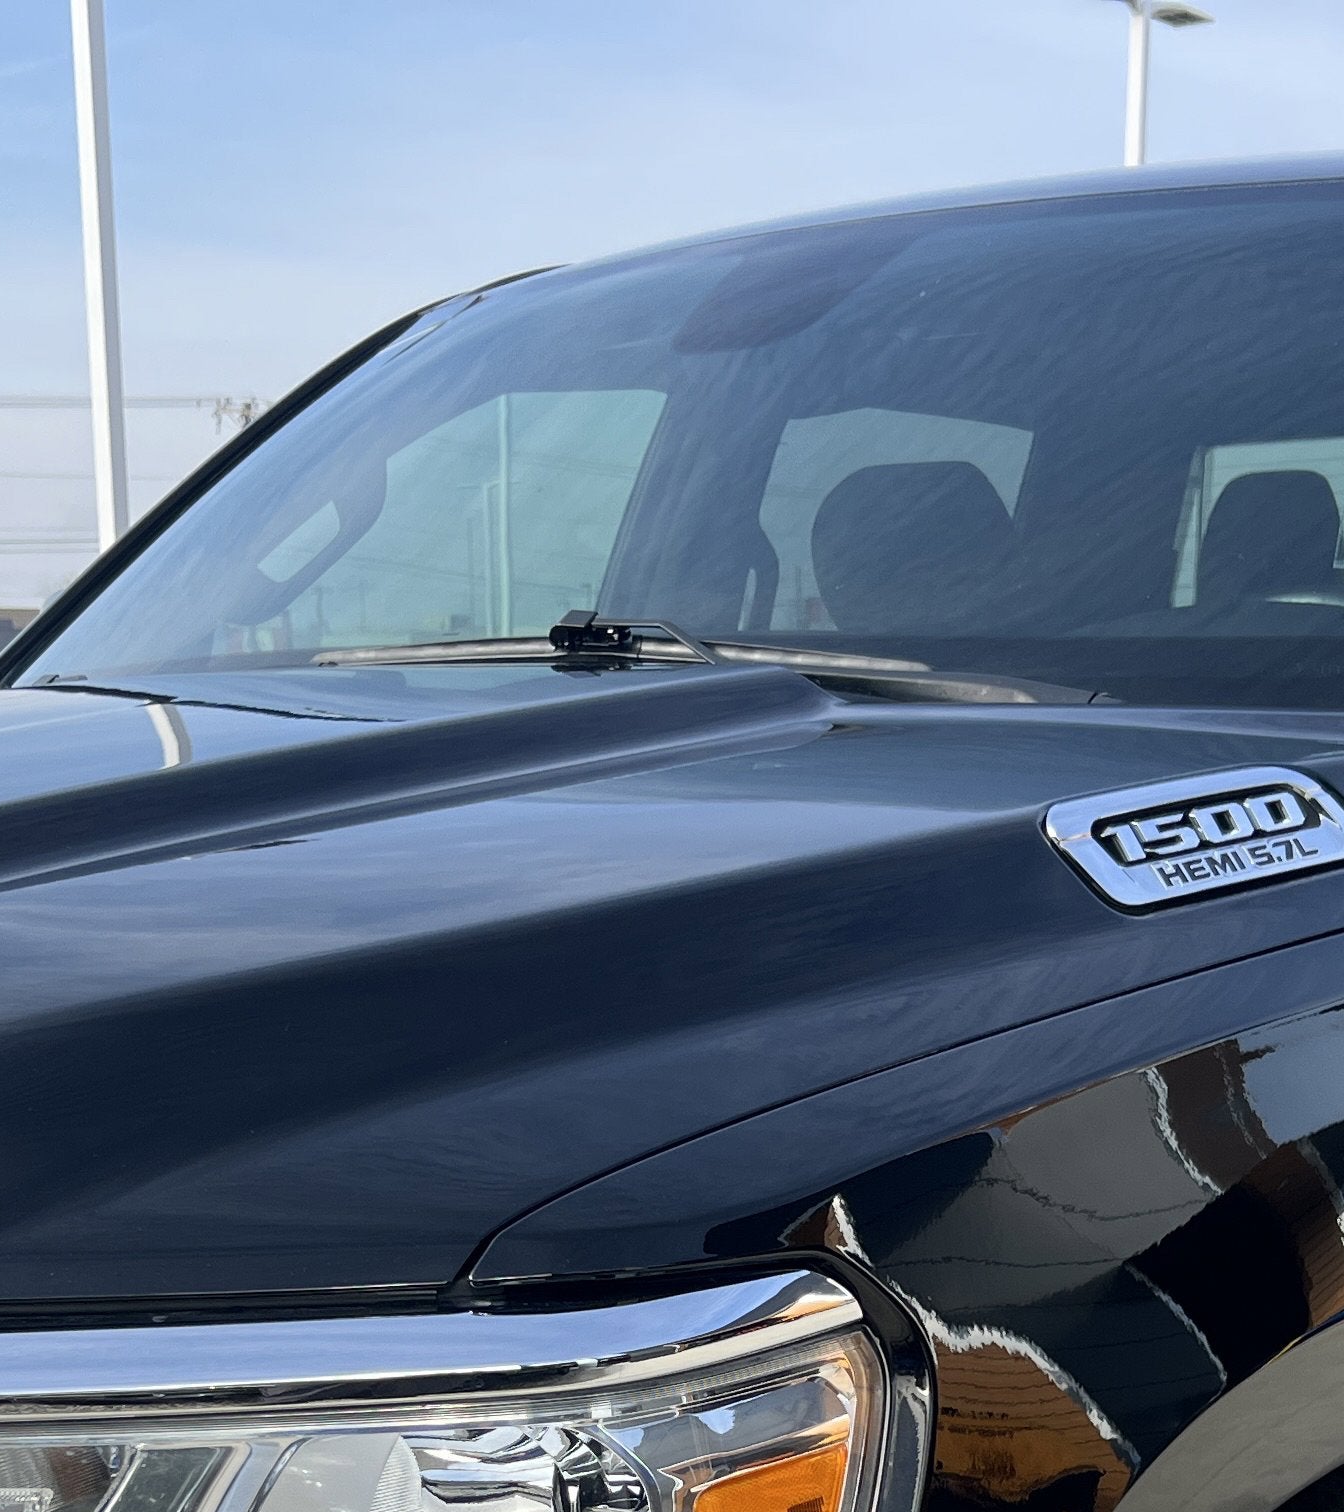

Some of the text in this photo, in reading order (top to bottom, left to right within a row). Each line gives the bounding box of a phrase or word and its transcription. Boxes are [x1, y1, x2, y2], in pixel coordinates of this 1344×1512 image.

[1101, 790, 1307, 864] 1500
[1156, 837, 1320, 888] HEMI 5.7L
